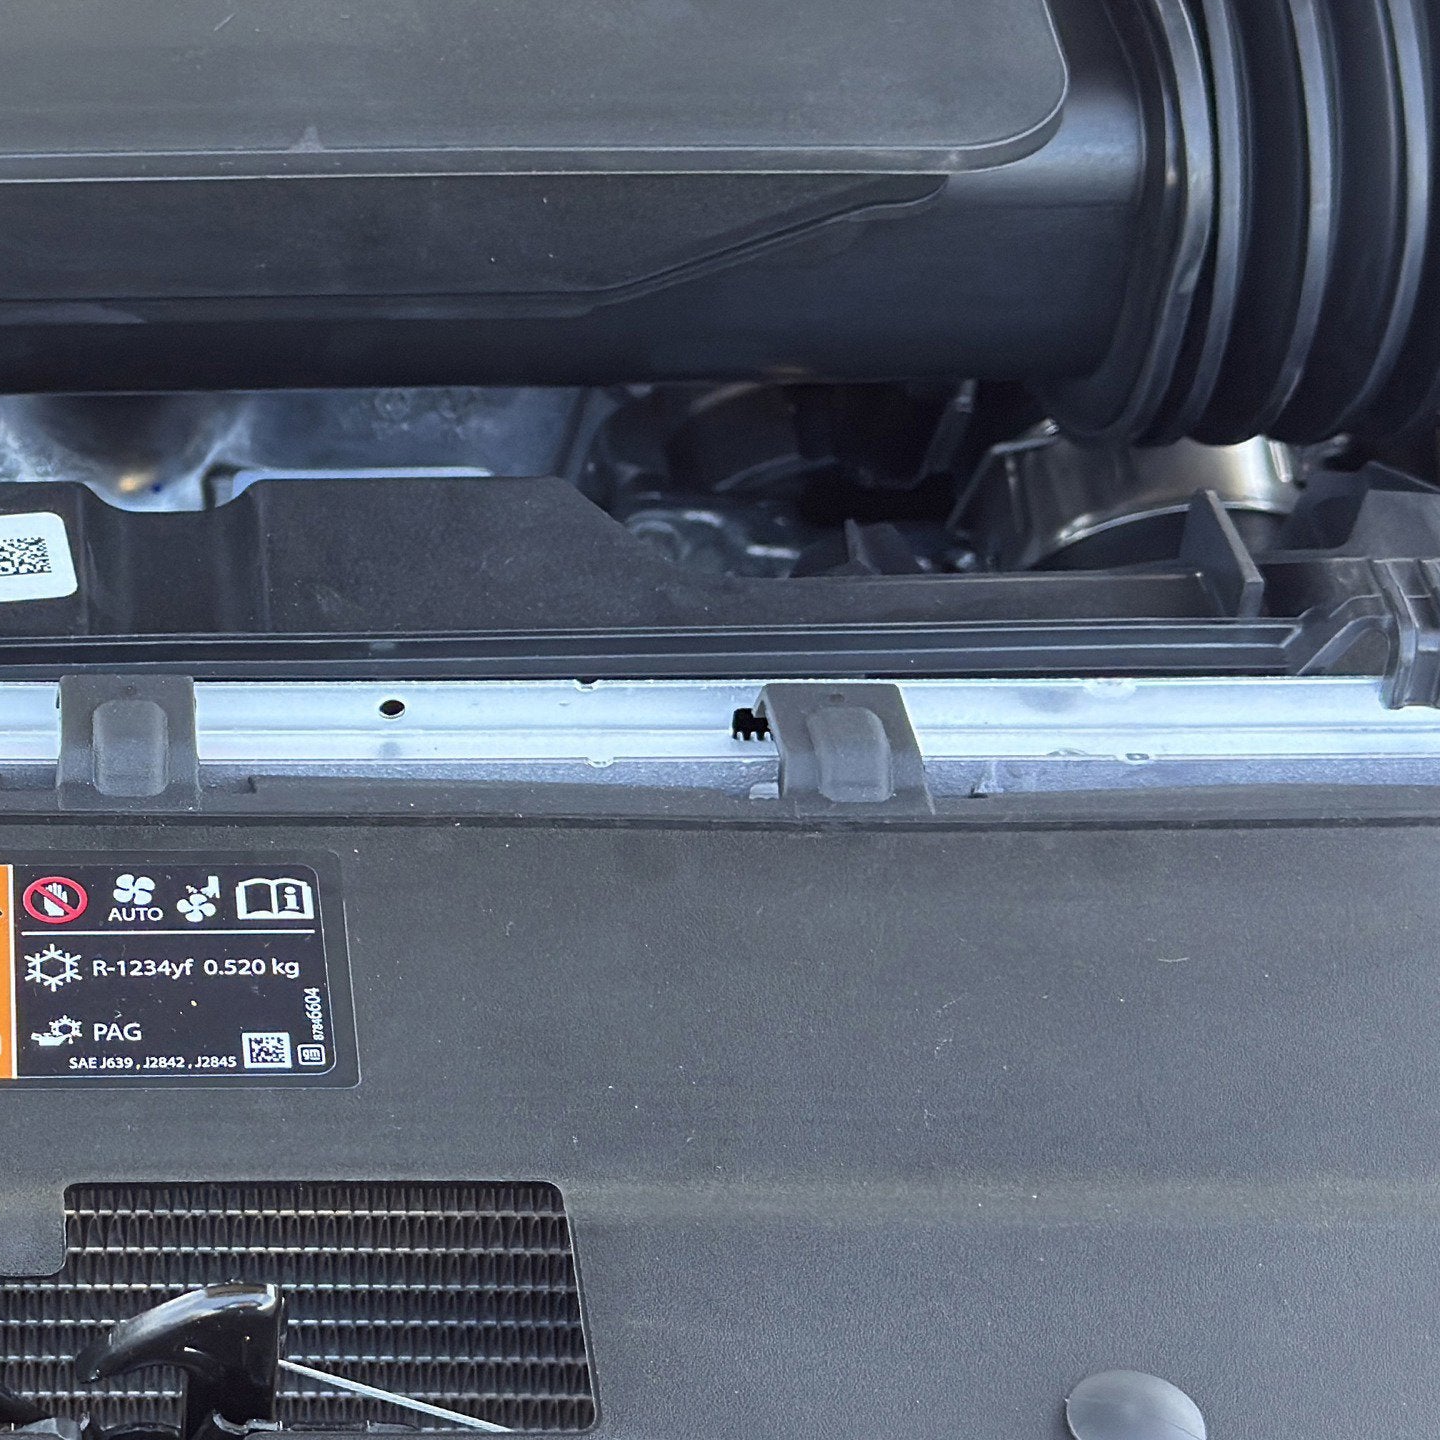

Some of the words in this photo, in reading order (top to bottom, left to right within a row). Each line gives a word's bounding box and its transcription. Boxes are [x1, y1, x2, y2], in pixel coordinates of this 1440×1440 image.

[108, 907, 164, 922] AUTO
[92, 957, 194, 980] R-1234yf
[203, 958, 266, 975] 0.520
[271, 957, 300, 980] kg
[303, 987, 325, 1041] 87846604
[93, 1022, 142, 1042] PAG
[69, 1057, 97, 1070] SAE
[194, 1056, 238, 1068] J2845
[302, 1048, 321, 1061] gm
